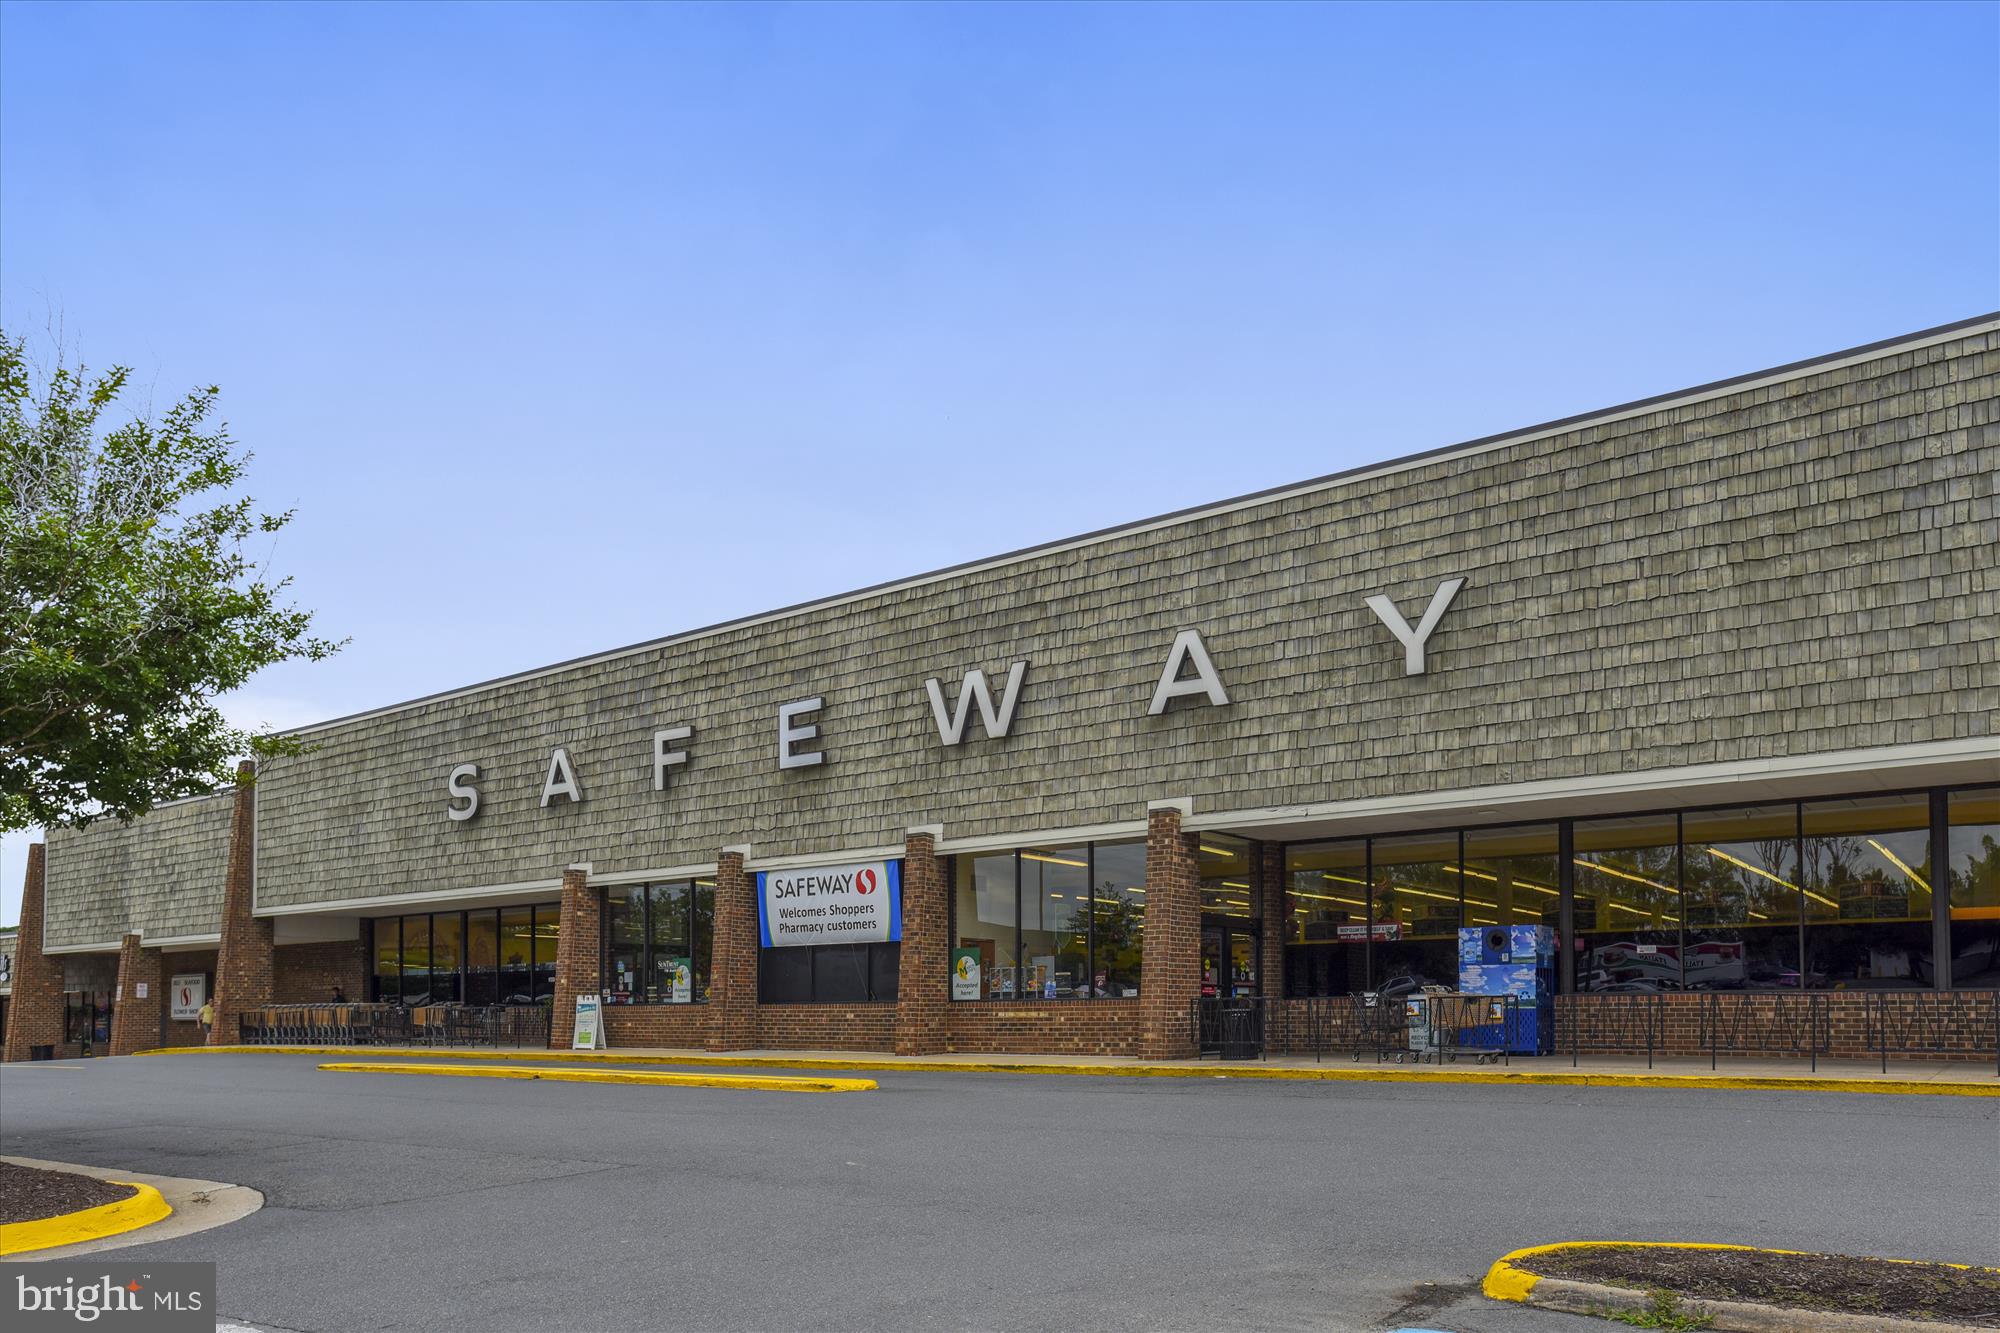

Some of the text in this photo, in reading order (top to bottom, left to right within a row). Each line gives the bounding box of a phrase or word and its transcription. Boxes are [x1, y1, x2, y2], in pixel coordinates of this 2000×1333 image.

[448, 577, 1468, 822] SAFEWAY
[775, 873, 853, 898] SAFEWAY
[779, 904, 874, 918] Welcomes Shoppers
[779, 920, 876, 934] Pharmacy customers
